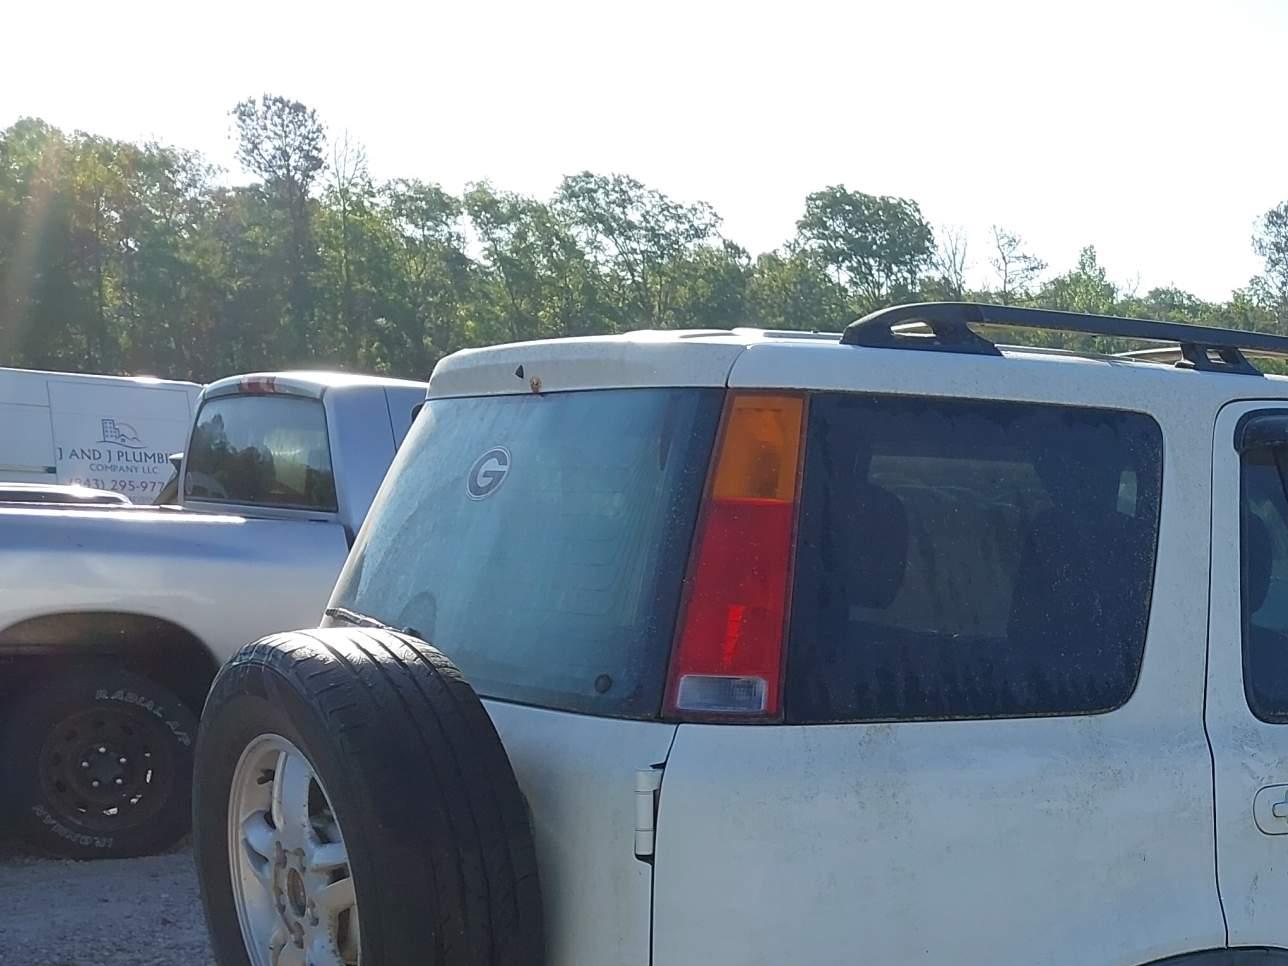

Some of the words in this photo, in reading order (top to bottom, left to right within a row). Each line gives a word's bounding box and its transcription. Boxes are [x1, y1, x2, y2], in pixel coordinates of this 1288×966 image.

[58, 447, 63, 460] J
[69, 448, 102, 460] AND
[108, 451, 112, 463] J
[117, 450, 171, 464] PLUMBI
[89, 463, 139, 473] COMPANY
[142, 465, 159, 474] LLC
[467, 448, 508, 497] G
